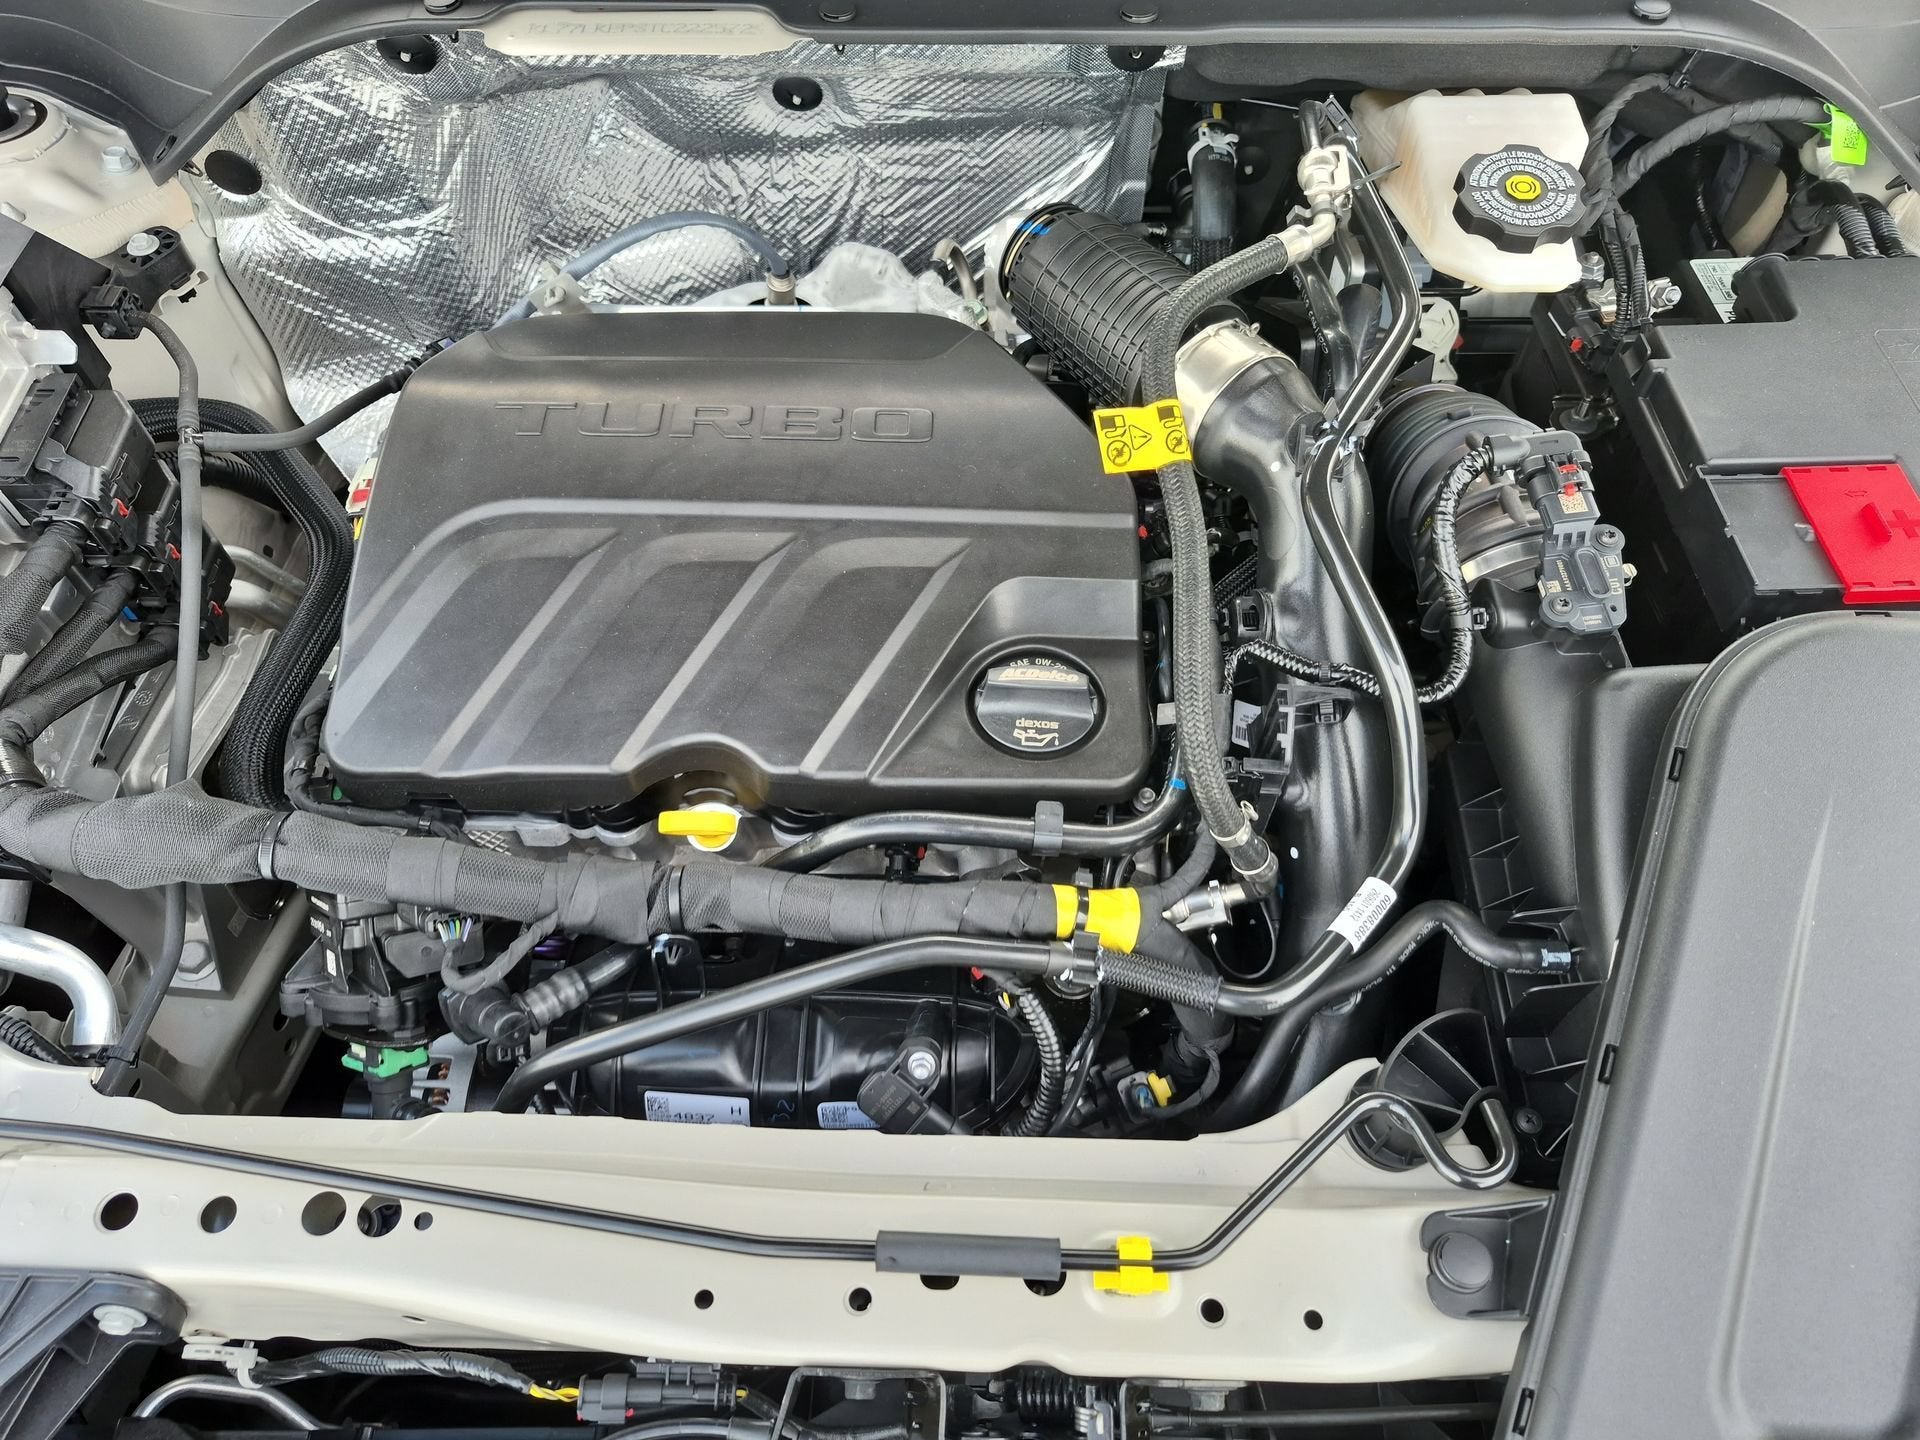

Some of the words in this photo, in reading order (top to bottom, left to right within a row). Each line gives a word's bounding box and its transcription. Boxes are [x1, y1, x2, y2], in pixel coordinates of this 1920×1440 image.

[1481, 191, 1494, 201] CAP
[1489, 200, 1514, 217] BEFORE
[1481, 204, 1502, 218] FLUID
[1500, 214, 1523, 226] FROM
[1522, 219, 1529, 227] A
[1528, 215, 1556, 227] SEALED
[1553, 193, 1577, 220] CONTAINER
[1490, 189, 1518, 210] WARNING:
[1519, 203, 1543, 212] CLEAN
[1540, 192, 1557, 208] FILLER
[495, 402, 934, 443] TURBO
[998, 667, 1080, 682] ACDelco
[1009, 658, 1031, 669] SAE
[1015, 717, 1060, 730] dexos
[1354, 894, 1392, 942] 60008388
